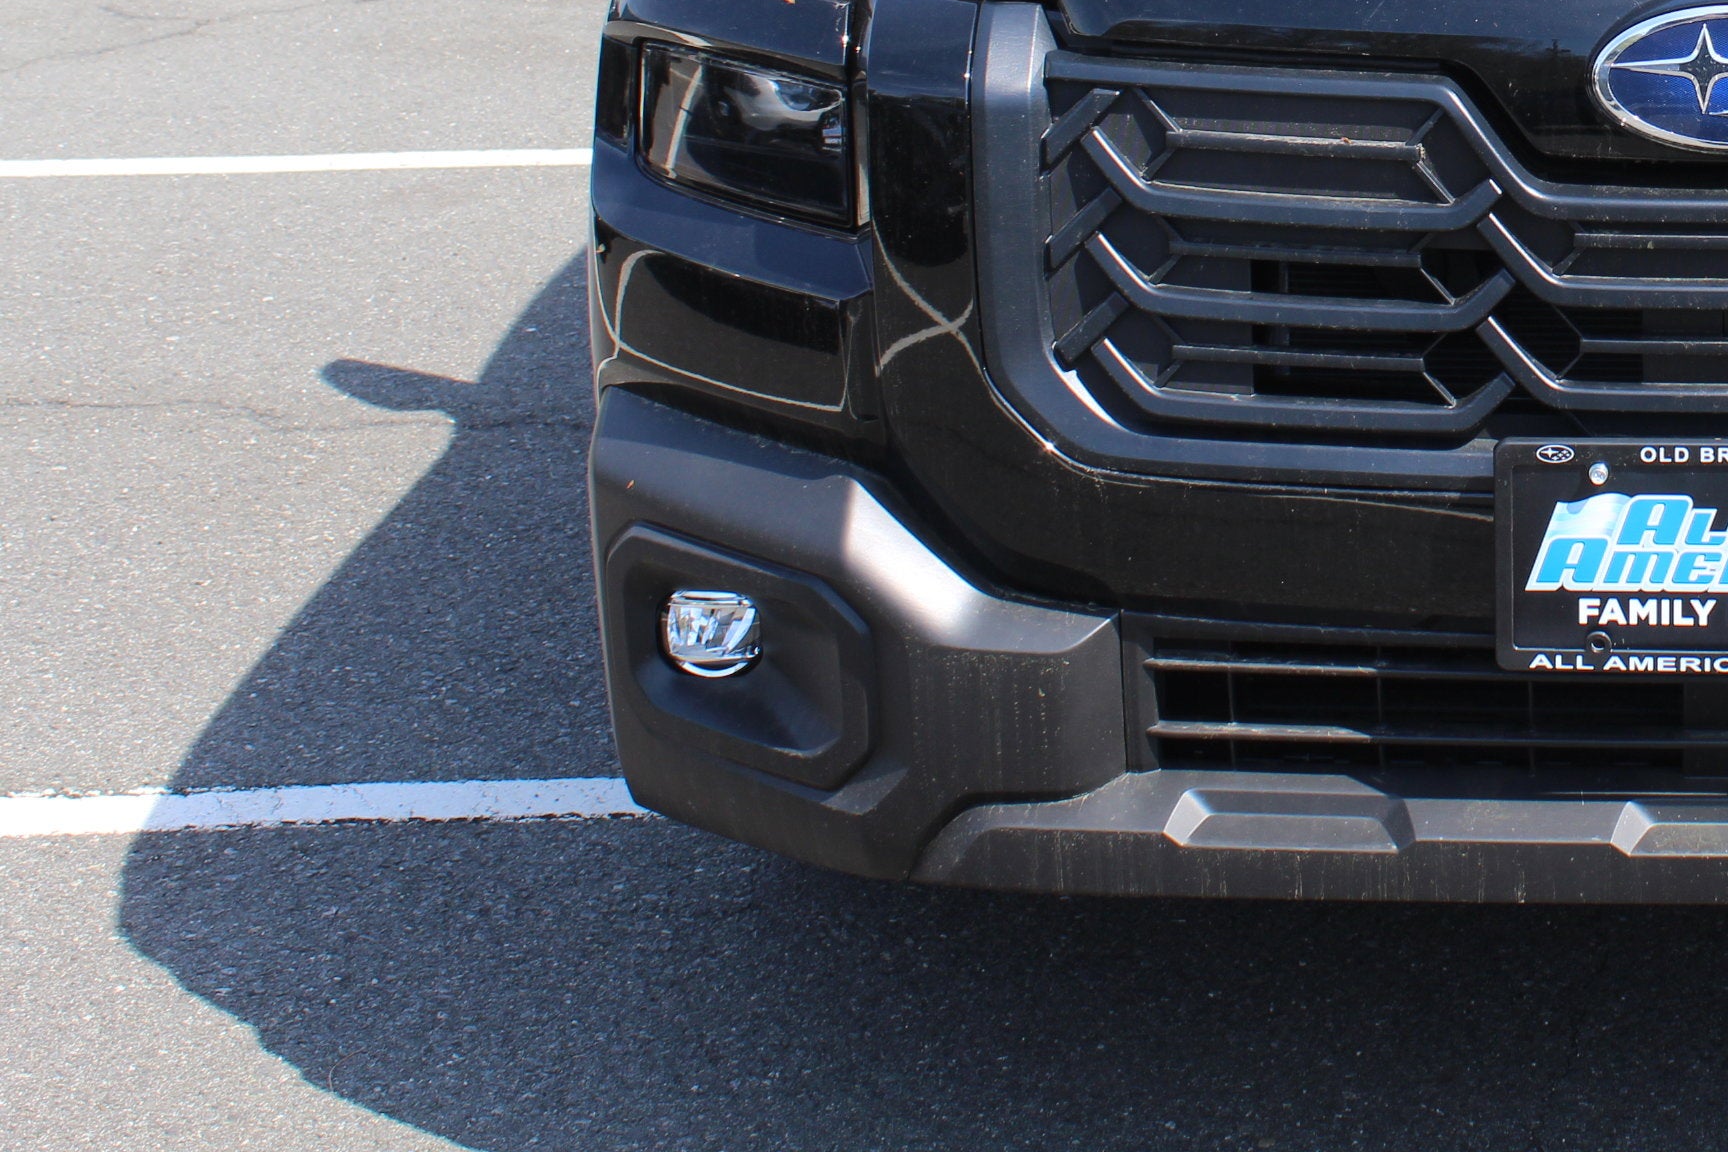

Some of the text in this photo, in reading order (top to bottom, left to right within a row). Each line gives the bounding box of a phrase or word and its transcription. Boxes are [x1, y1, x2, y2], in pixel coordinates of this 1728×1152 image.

[1640, 447, 1690, 463] OLD
[1578, 598, 1716, 627] FAMILY
[1529, 654, 1594, 671] ALL
